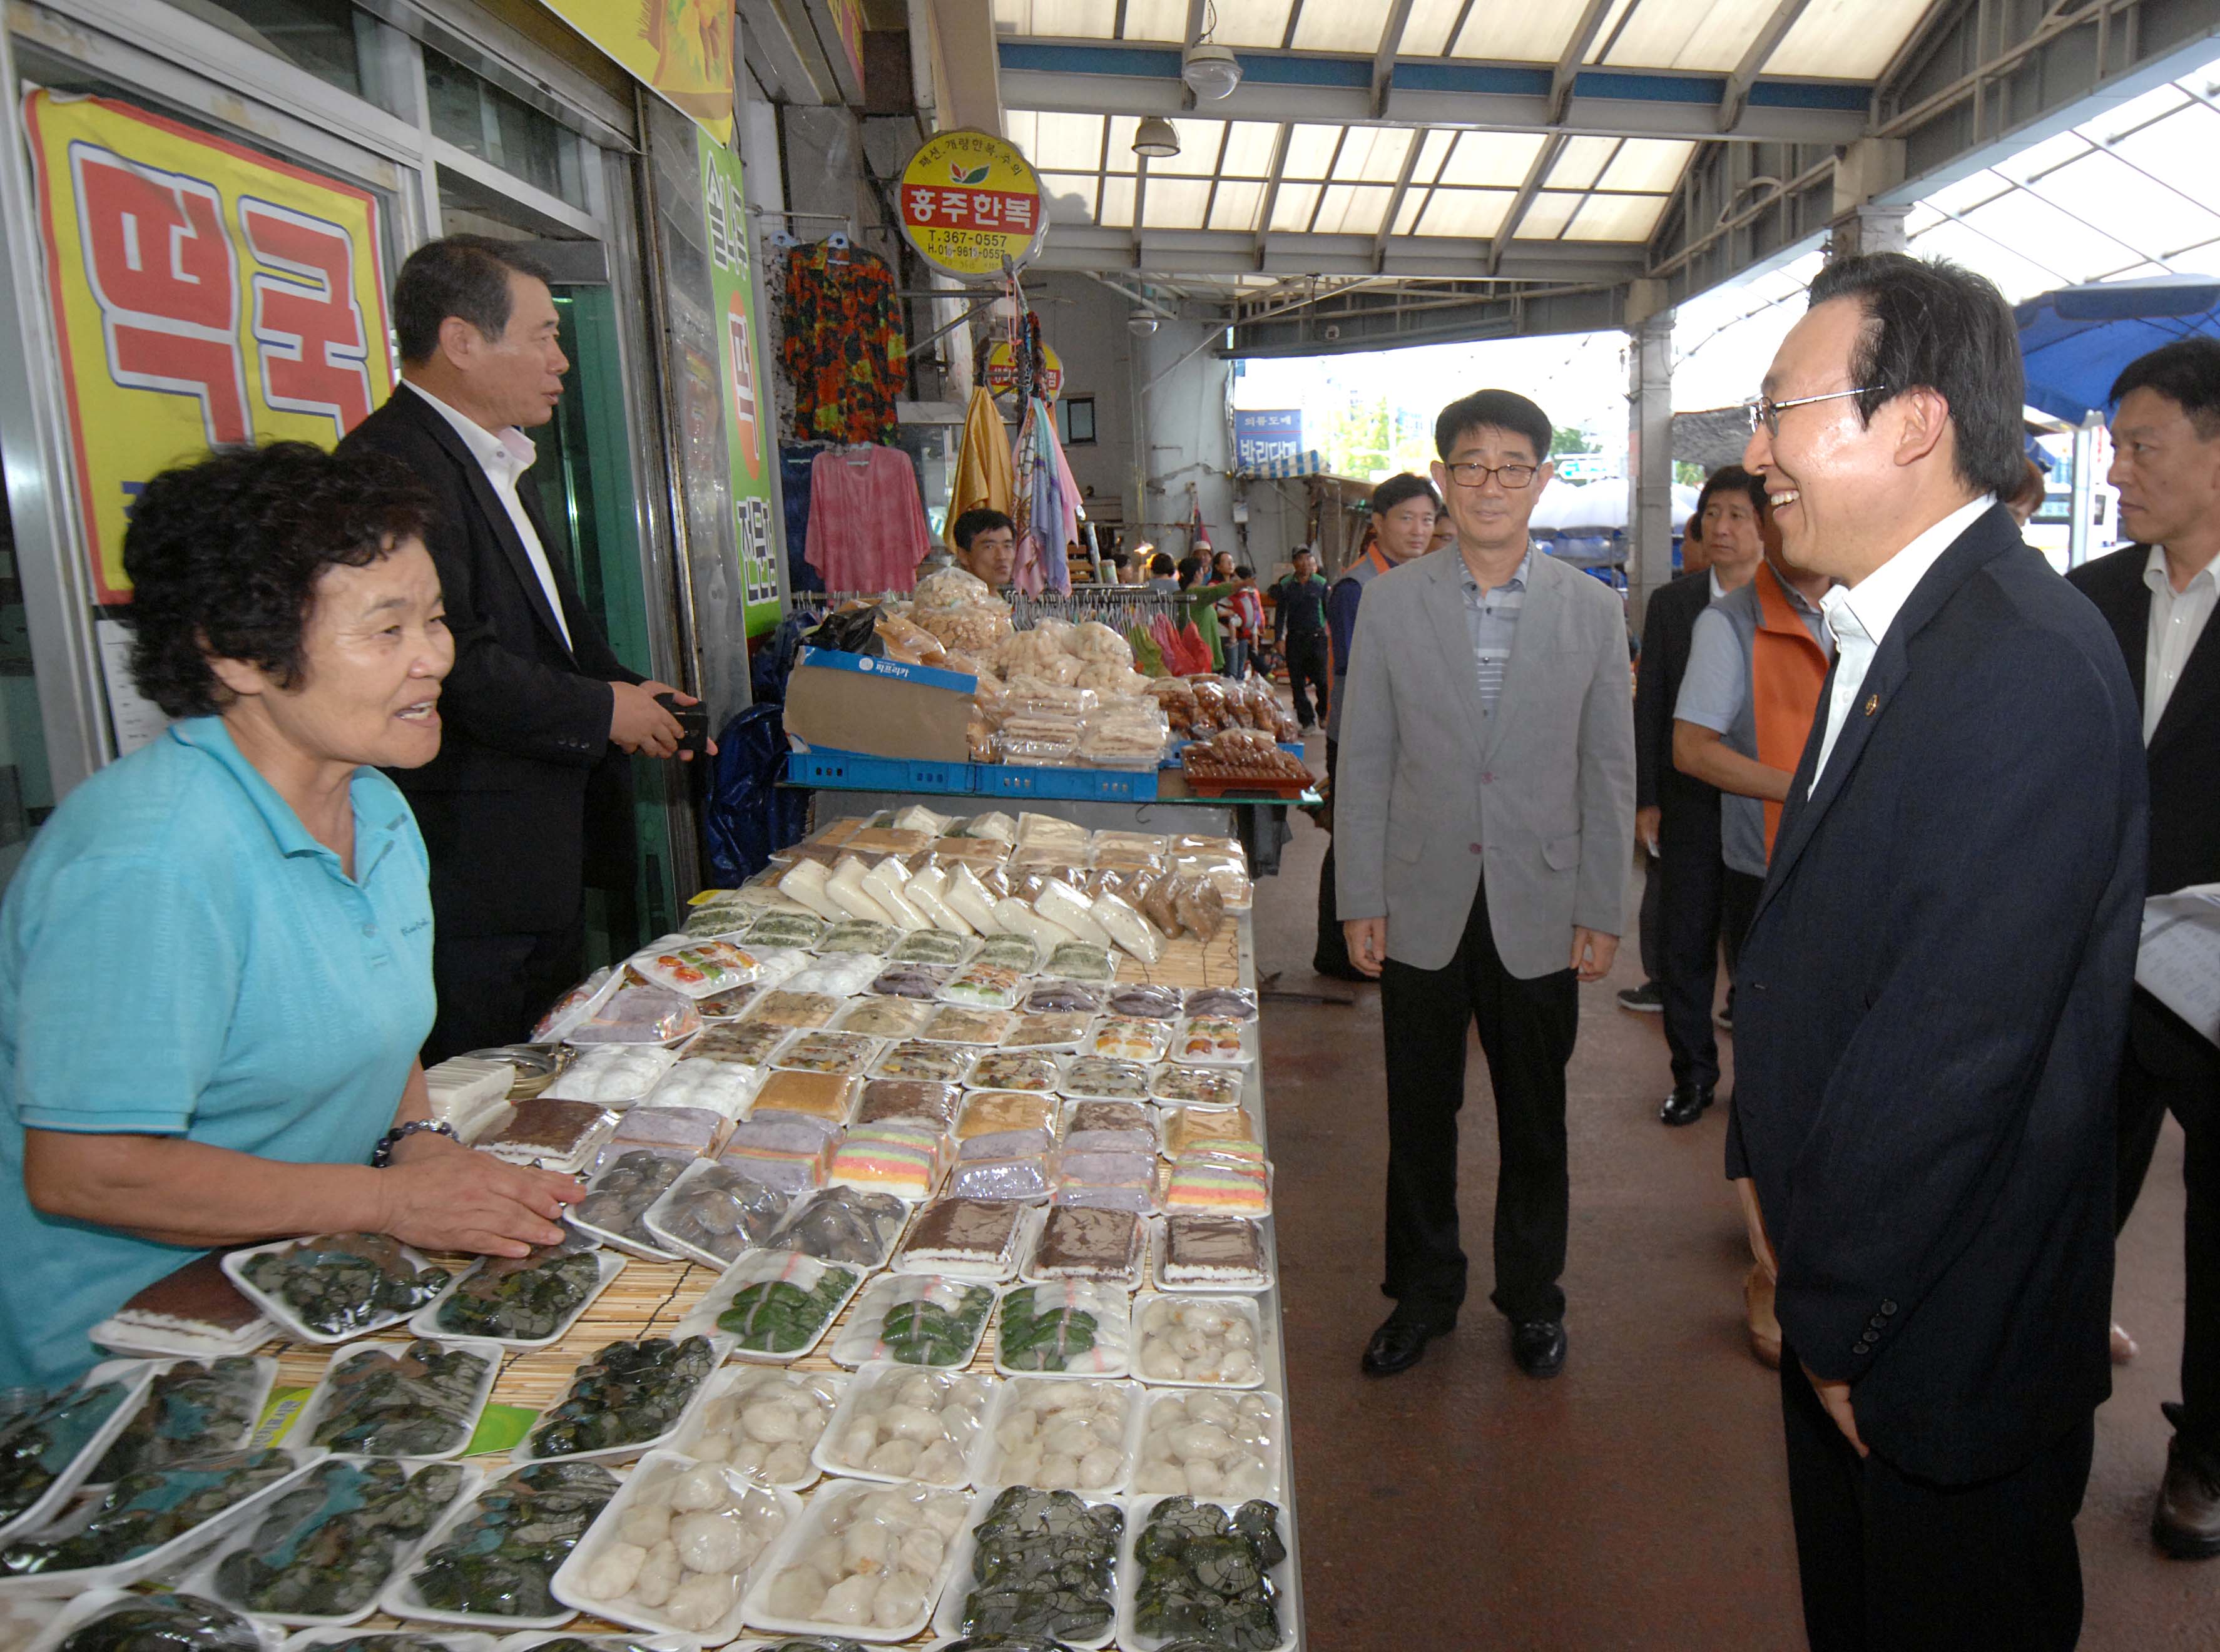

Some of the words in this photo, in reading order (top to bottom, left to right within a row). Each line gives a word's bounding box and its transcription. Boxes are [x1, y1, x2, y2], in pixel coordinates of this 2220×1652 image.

[910, 189, 1031, 228] 홍주한복
[728, 311, 760, 461] 떡
[1245, 416, 1291, 426] 의류도매
[1240, 439, 1297, 464] 박리다매
[736, 496, 780, 606] 전문점
